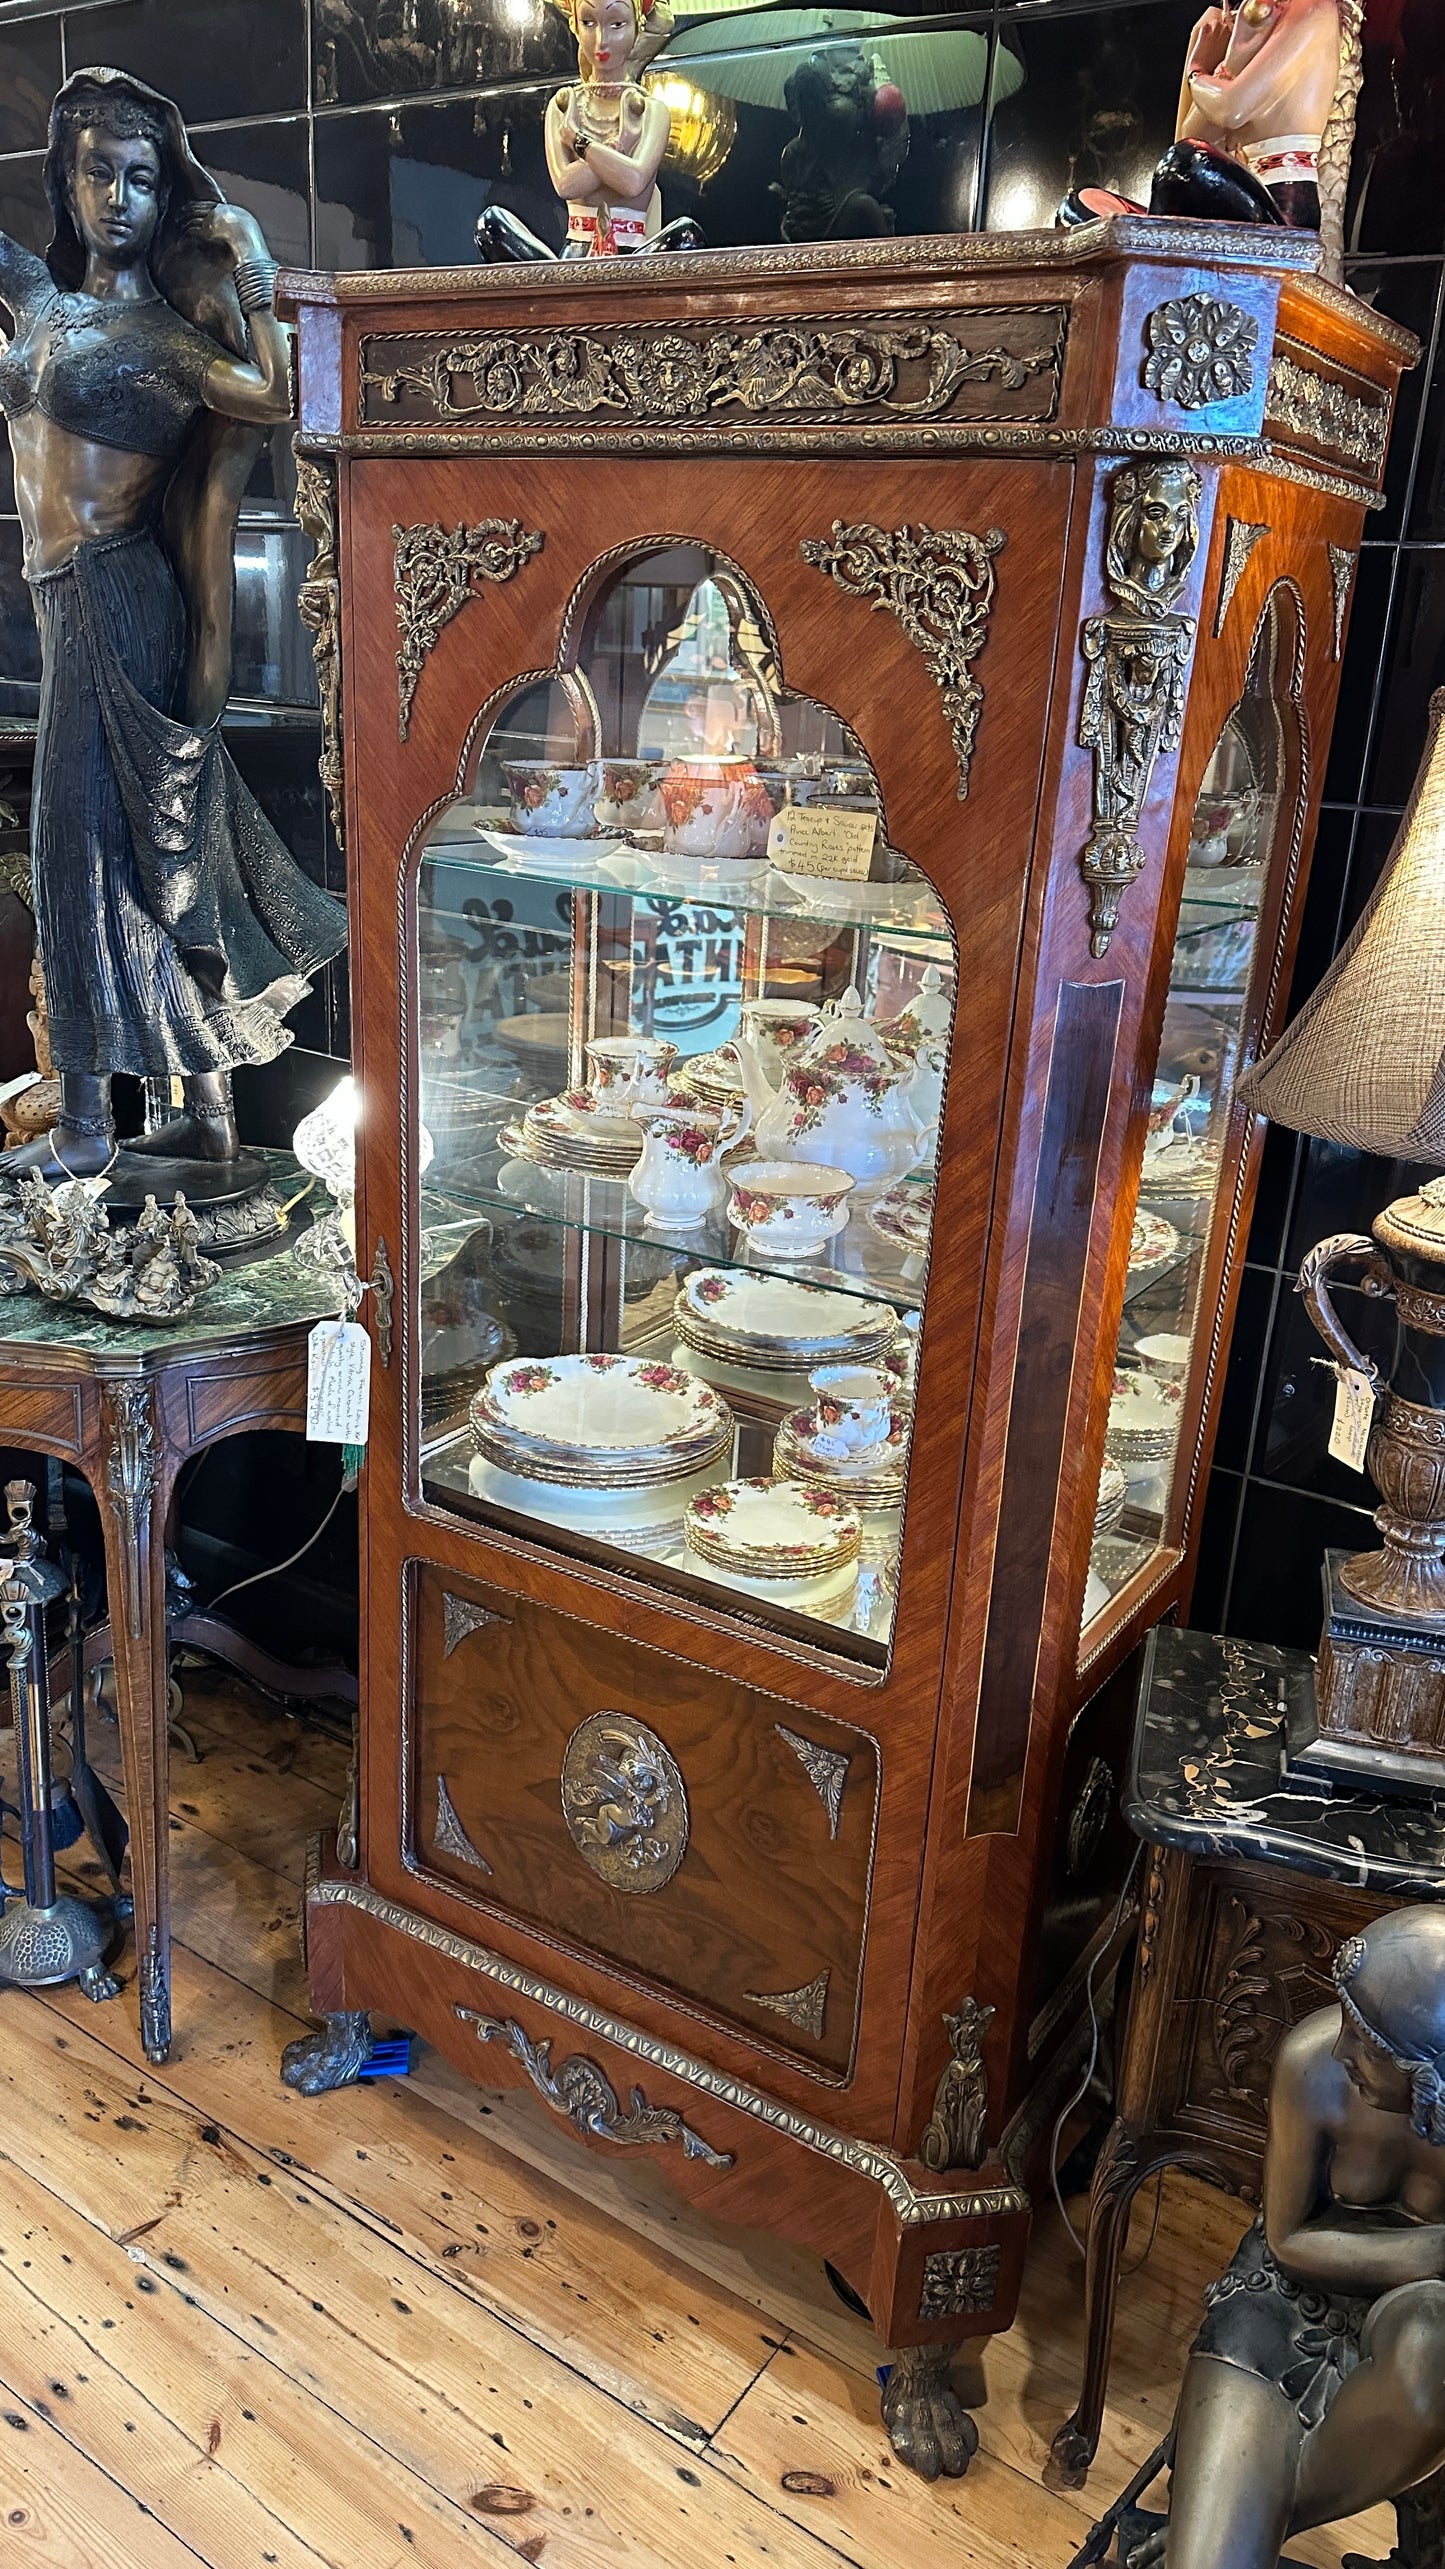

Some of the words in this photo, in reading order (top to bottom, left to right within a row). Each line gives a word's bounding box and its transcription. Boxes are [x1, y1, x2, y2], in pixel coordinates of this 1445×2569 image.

[787, 810, 796, 821] 12
[798, 812, 822, 827] Teacup
[833, 815, 858, 830] Saucer
[778, 848, 807, 858] trimmed
[841, 856, 858, 865] gold
[789, 838, 818, 853] Country
[847, 844, 871, 855] pattern
[788, 857, 815, 873] $45
[356, 1339, 367, 1375] Stunning
[358, 1377, 366, 1404] French
[346, 1389, 355, 1418] Cabinet
[1363, 1397, 1371, 1420] Ornate
[354, 1409, 364, 1428] Louis
